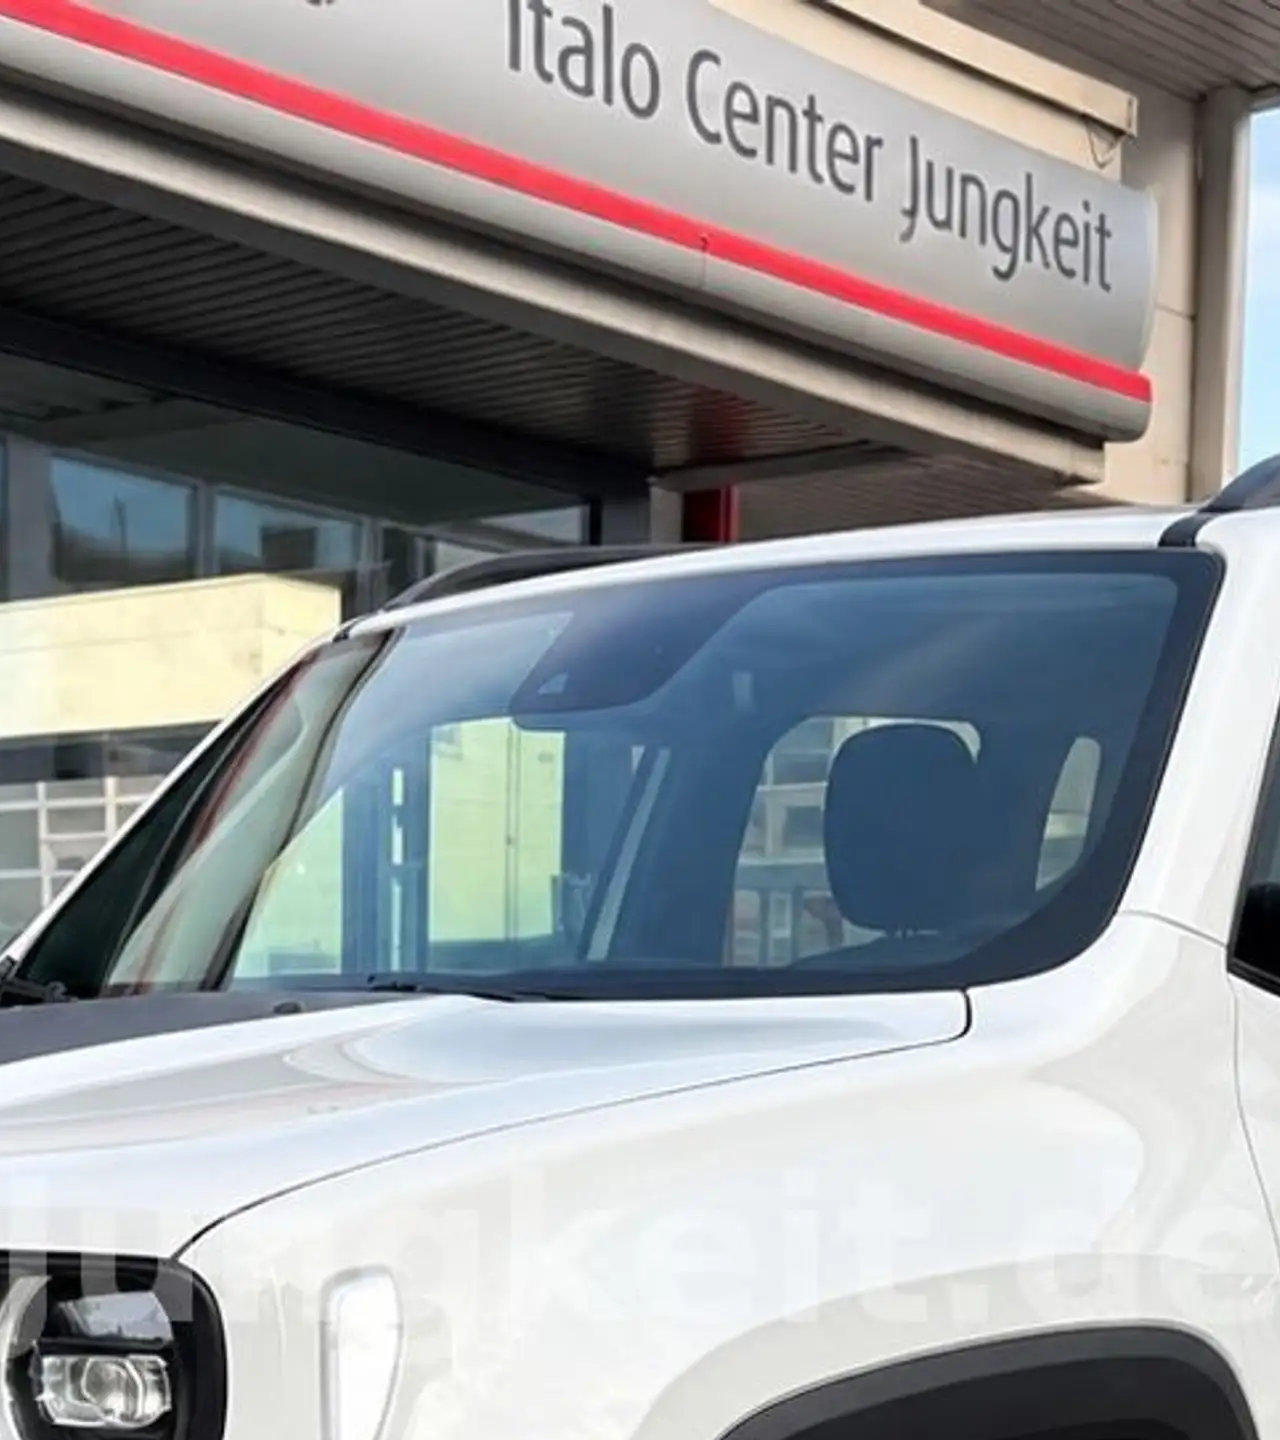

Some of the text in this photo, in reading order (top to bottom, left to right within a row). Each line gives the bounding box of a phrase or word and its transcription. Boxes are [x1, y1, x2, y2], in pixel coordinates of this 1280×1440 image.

[506, 0, 1114, 294] Italo Center Jungkeit
